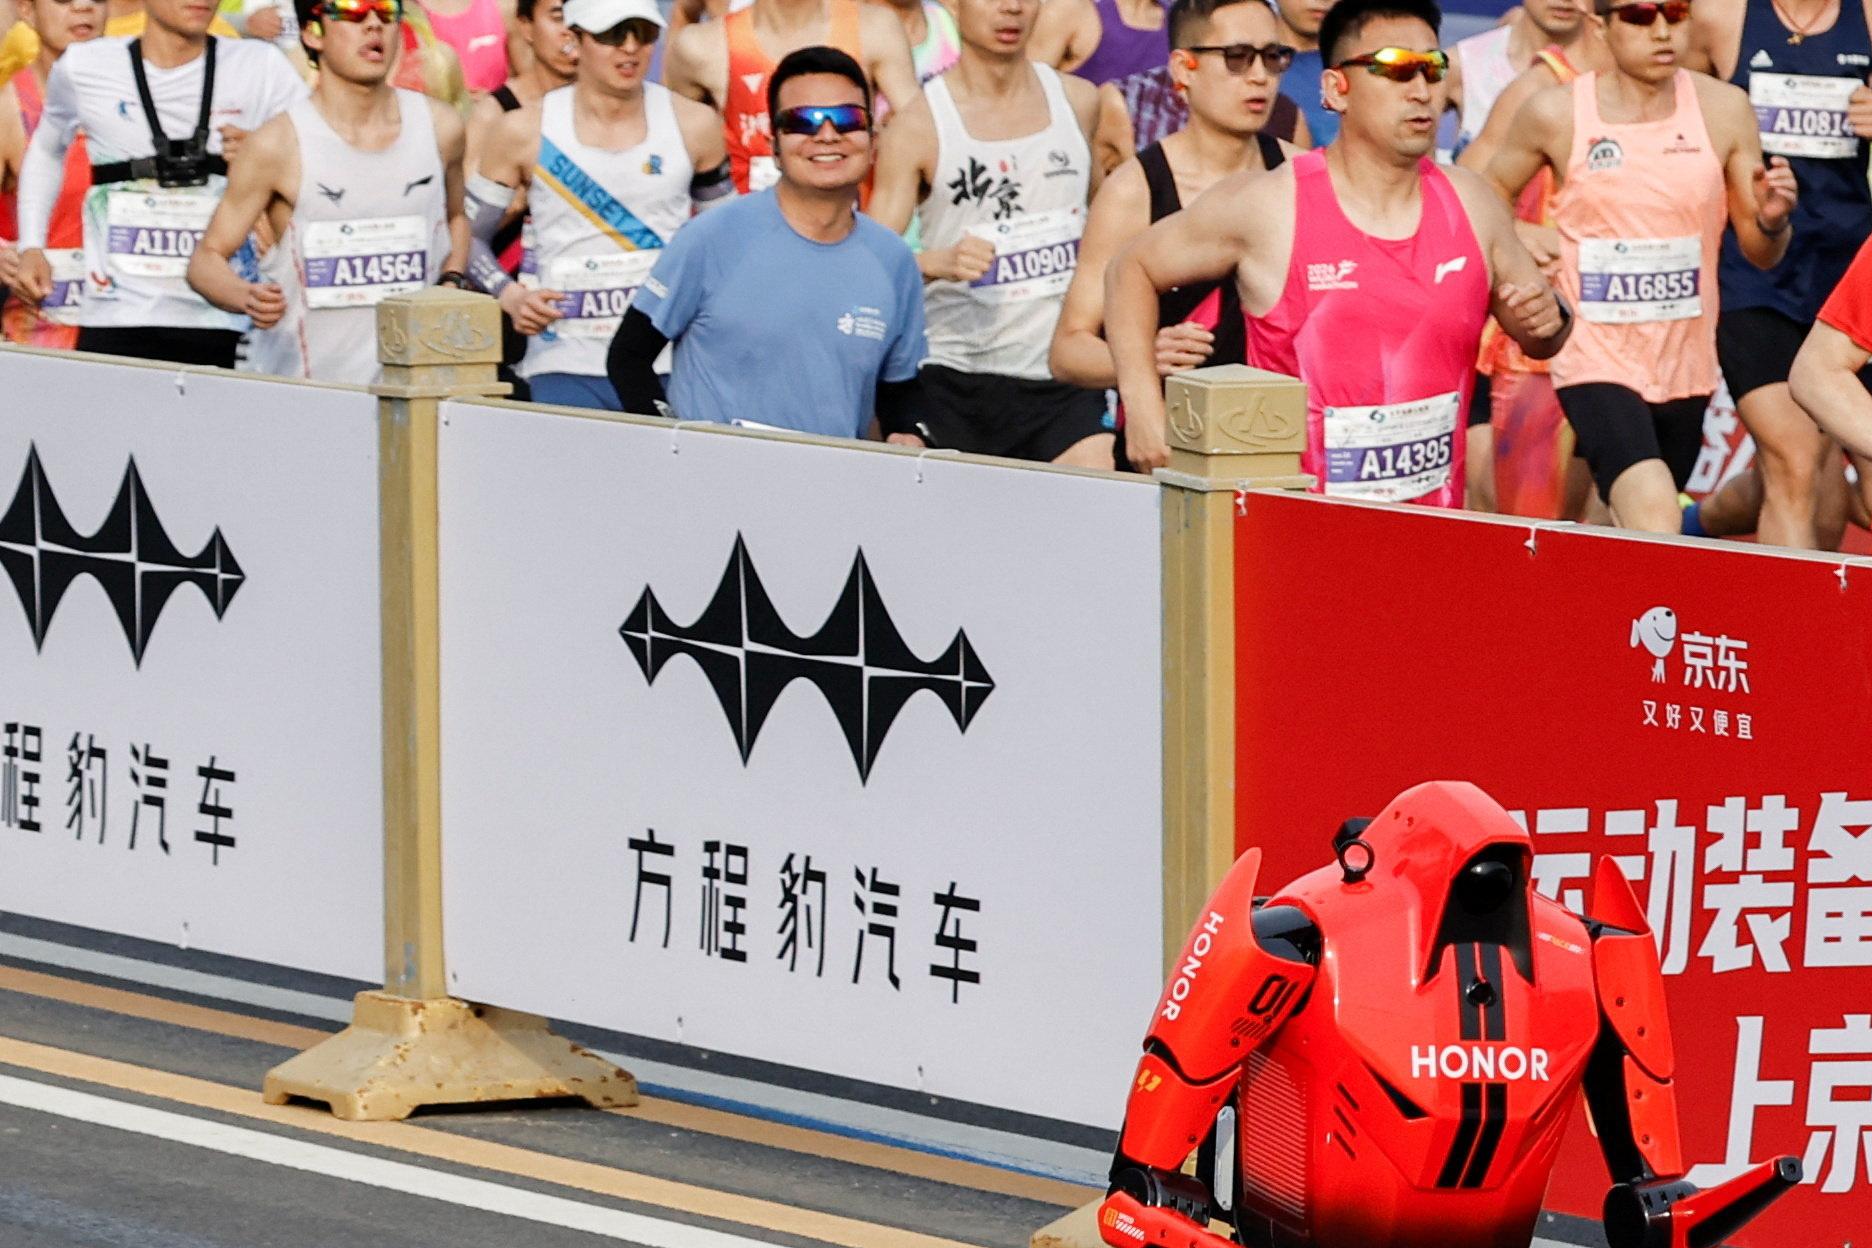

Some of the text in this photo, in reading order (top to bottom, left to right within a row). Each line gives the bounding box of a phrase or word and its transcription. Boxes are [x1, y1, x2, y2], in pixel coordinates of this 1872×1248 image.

[947, 156, 1025, 220] 北京
[132, 229, 204, 256] A110
[333, 253, 423, 286] A14564
[996, 243, 1077, 283] A10901
[1605, 270, 1695, 301] A16855
[1360, 435, 1452, 480] A14395
[1680, 630, 1751, 694] 京东
[1642, 700, 1753, 740] 又好又便宜
[627, 828, 981, 1004] 方程豹汽车
[1161, 911, 1225, 1021] HONOR
[1410, 1044, 1550, 1082] HONOR
